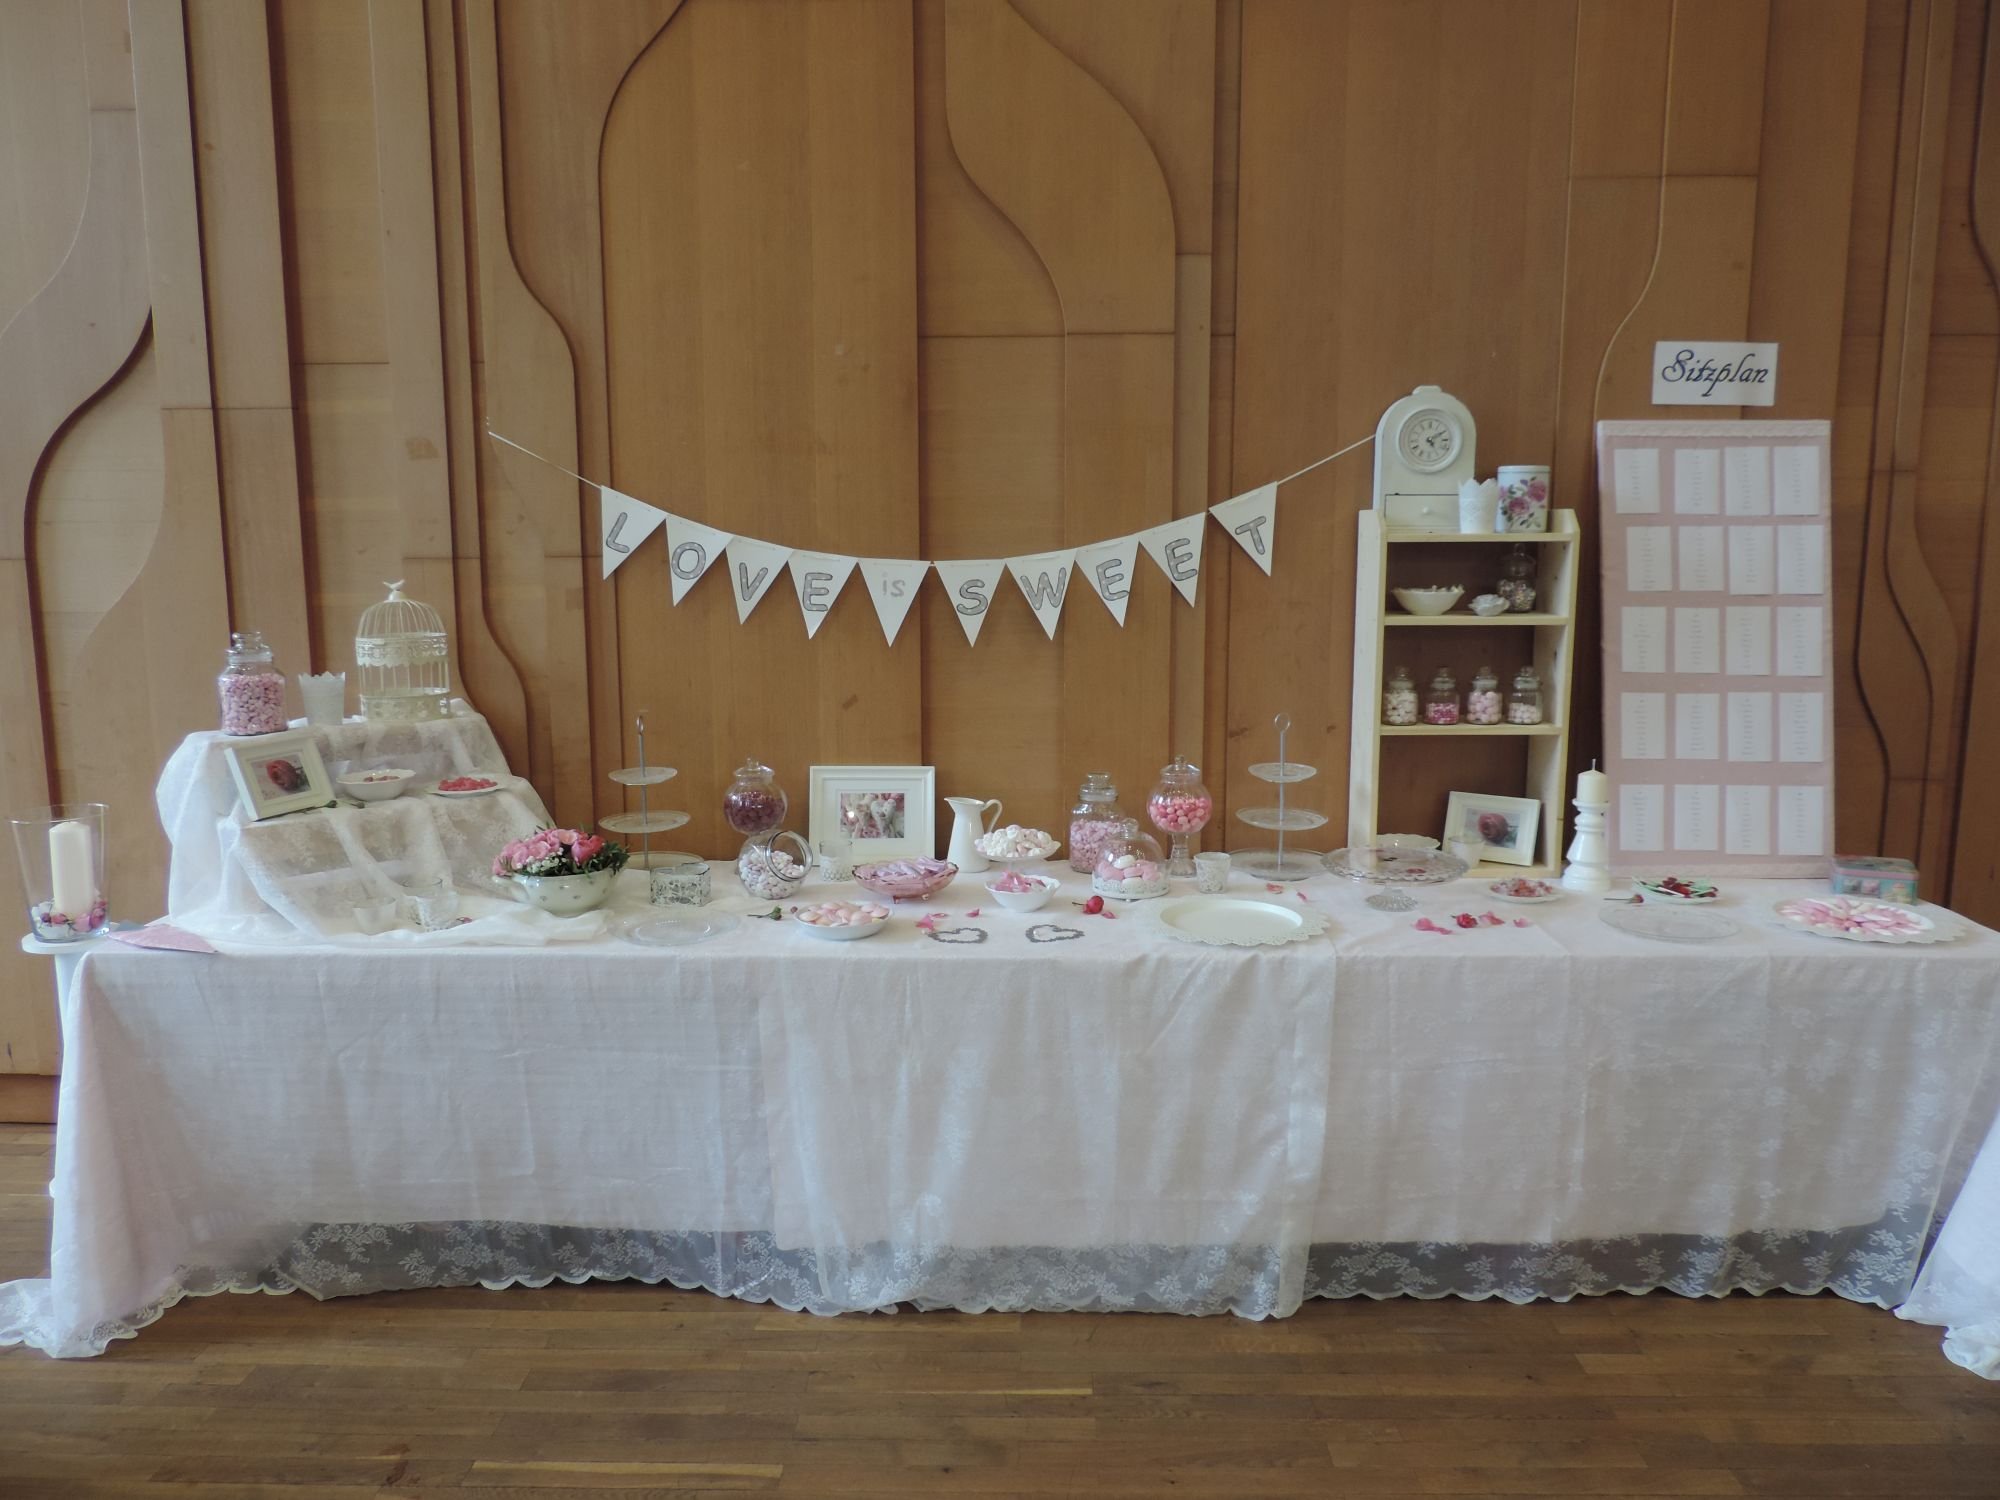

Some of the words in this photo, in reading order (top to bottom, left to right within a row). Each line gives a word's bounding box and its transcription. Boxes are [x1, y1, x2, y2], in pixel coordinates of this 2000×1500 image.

[1661, 349, 1768, 397] Sitzplan
[605, 512, 833, 613] LOVE
[881, 572, 906, 598] is
[957, 515, 1267, 617] SWEET
